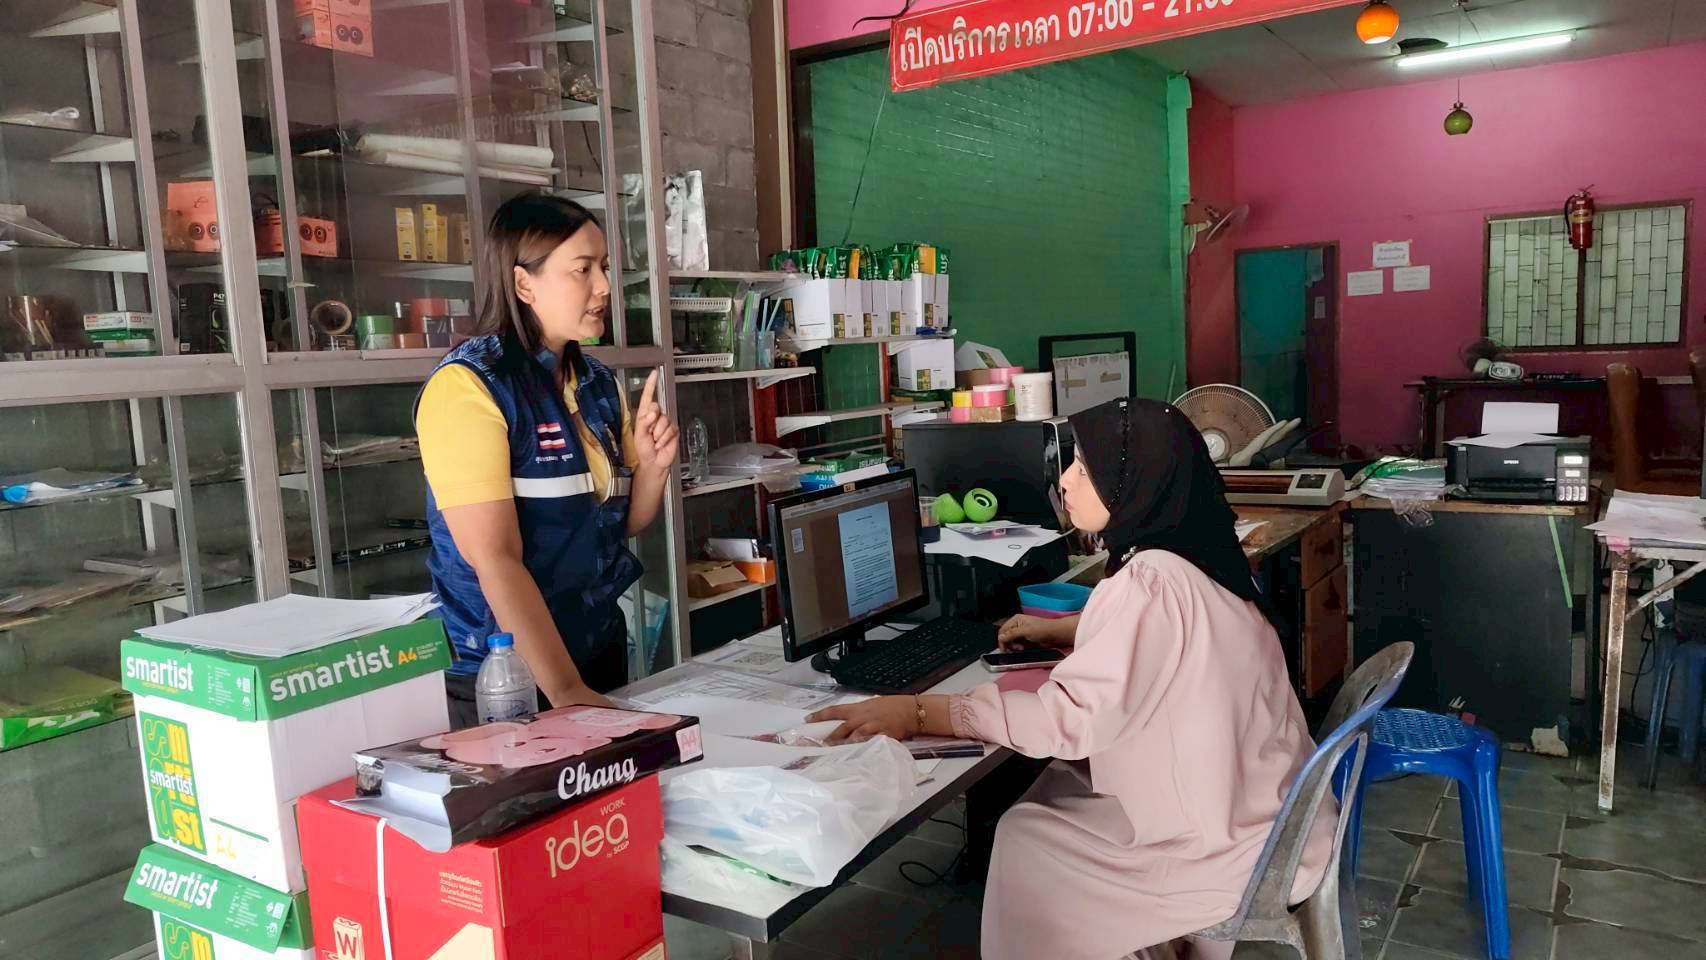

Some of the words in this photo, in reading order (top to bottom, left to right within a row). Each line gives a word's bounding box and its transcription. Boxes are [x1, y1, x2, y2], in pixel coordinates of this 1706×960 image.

[900, 16, 1007, 72] เปิดบริการ
[1014, 14, 1061, 49] เวลา
[1067, 0, 1134, 38] 07:00
[126, 656, 194, 692] smartist
[269, 644, 393, 702] smartist
[397, 648, 418, 666] A4
[150, 769, 194, 796] smartist
[557, 756, 638, 800] Chang
[600, 797, 625, 816] WORK
[545, 813, 629, 878] idea
[136, 862, 219, 910] smartist
[336, 930, 358, 959] W
